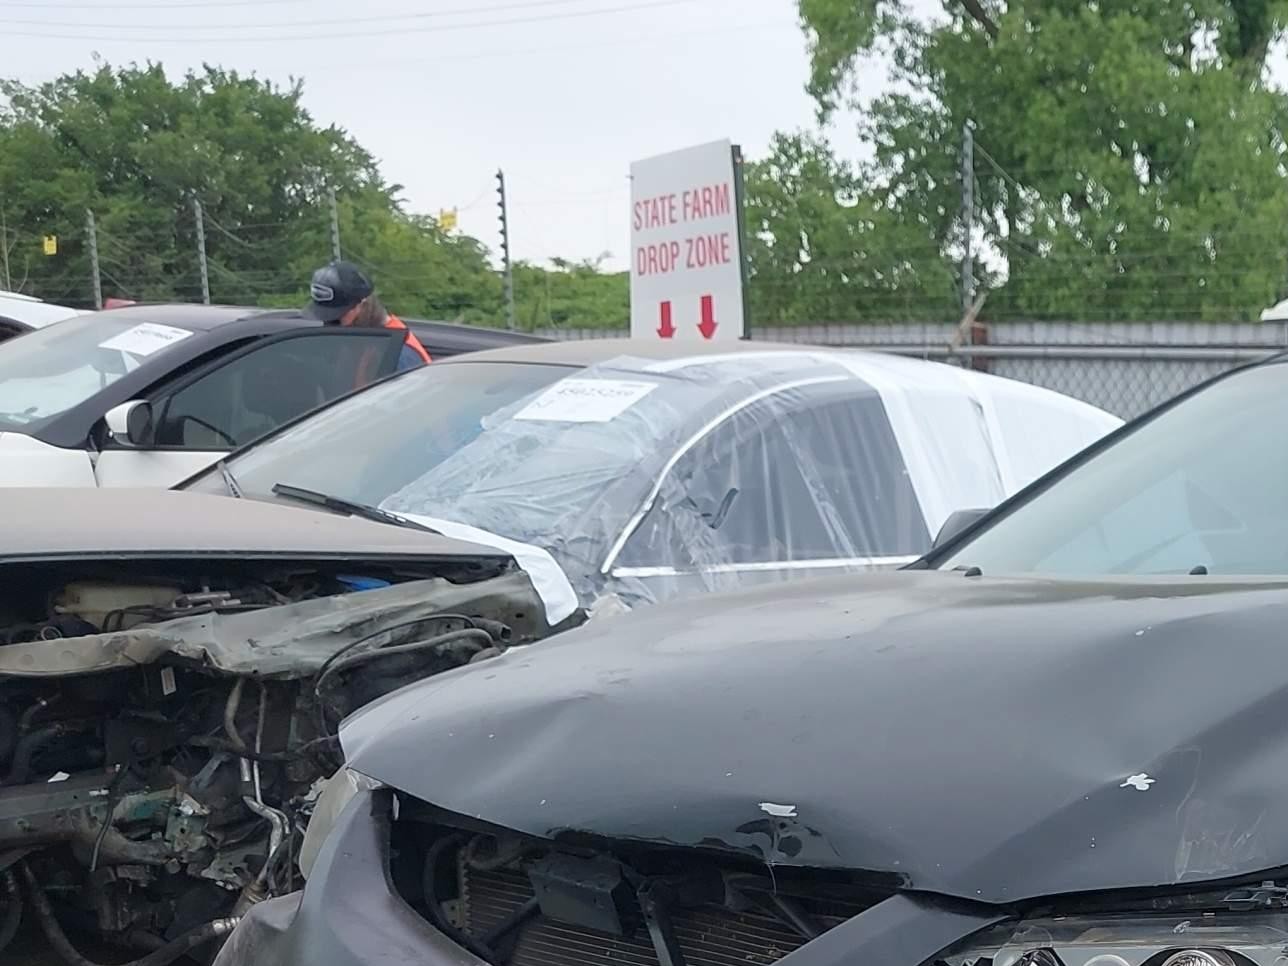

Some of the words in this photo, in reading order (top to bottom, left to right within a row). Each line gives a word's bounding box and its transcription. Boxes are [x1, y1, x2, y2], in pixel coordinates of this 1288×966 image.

[633, 194, 677, 231] STATE
[683, 183, 730, 221] FARM
[637, 241, 680, 276] DROP
[686, 232, 730, 268] ZONE
